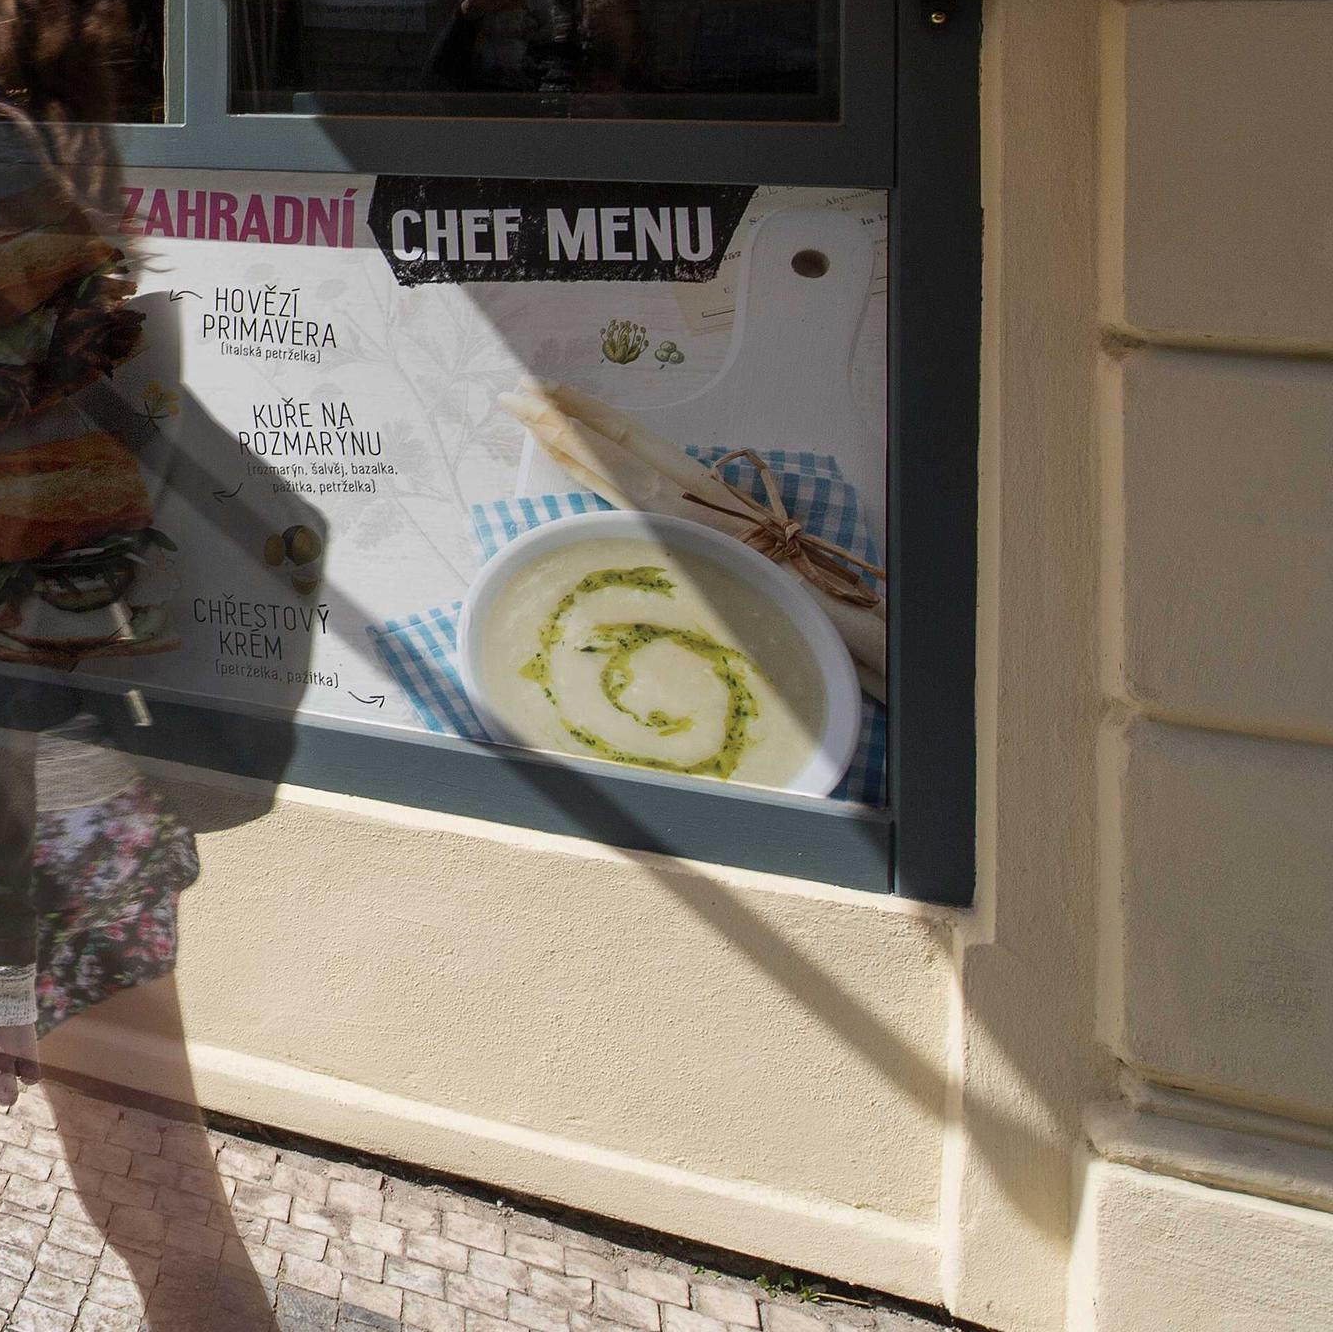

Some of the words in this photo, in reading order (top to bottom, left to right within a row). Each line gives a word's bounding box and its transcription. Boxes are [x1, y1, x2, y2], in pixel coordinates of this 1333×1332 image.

[118, 187, 358, 249] ZAHRADNÍ
[391, 208, 522, 261] CHEF
[545, 206, 715, 261] MENU
[215, 284, 300, 318] HOVĚZÍ
[203, 314, 337, 349] PRIMAVERA
[220, 341, 262, 358] (italská
[265, 345, 321, 365] petrželka)
[252, 397, 313, 429] KUŘE
[321, 401, 354, 428] NA
[238, 425, 382, 456] ROZMARÝNU
[351, 462, 398, 476] bazalka,
[272, 479, 316, 495] pažitka,
[319, 479, 377, 496] petrželka)
[193, 592, 330, 634] CHŘESTOVÝ
[219, 628, 283, 661] KRÉM
[215, 658, 282, 682] (petrželka,
[287, 669, 340, 689] pažitka)
